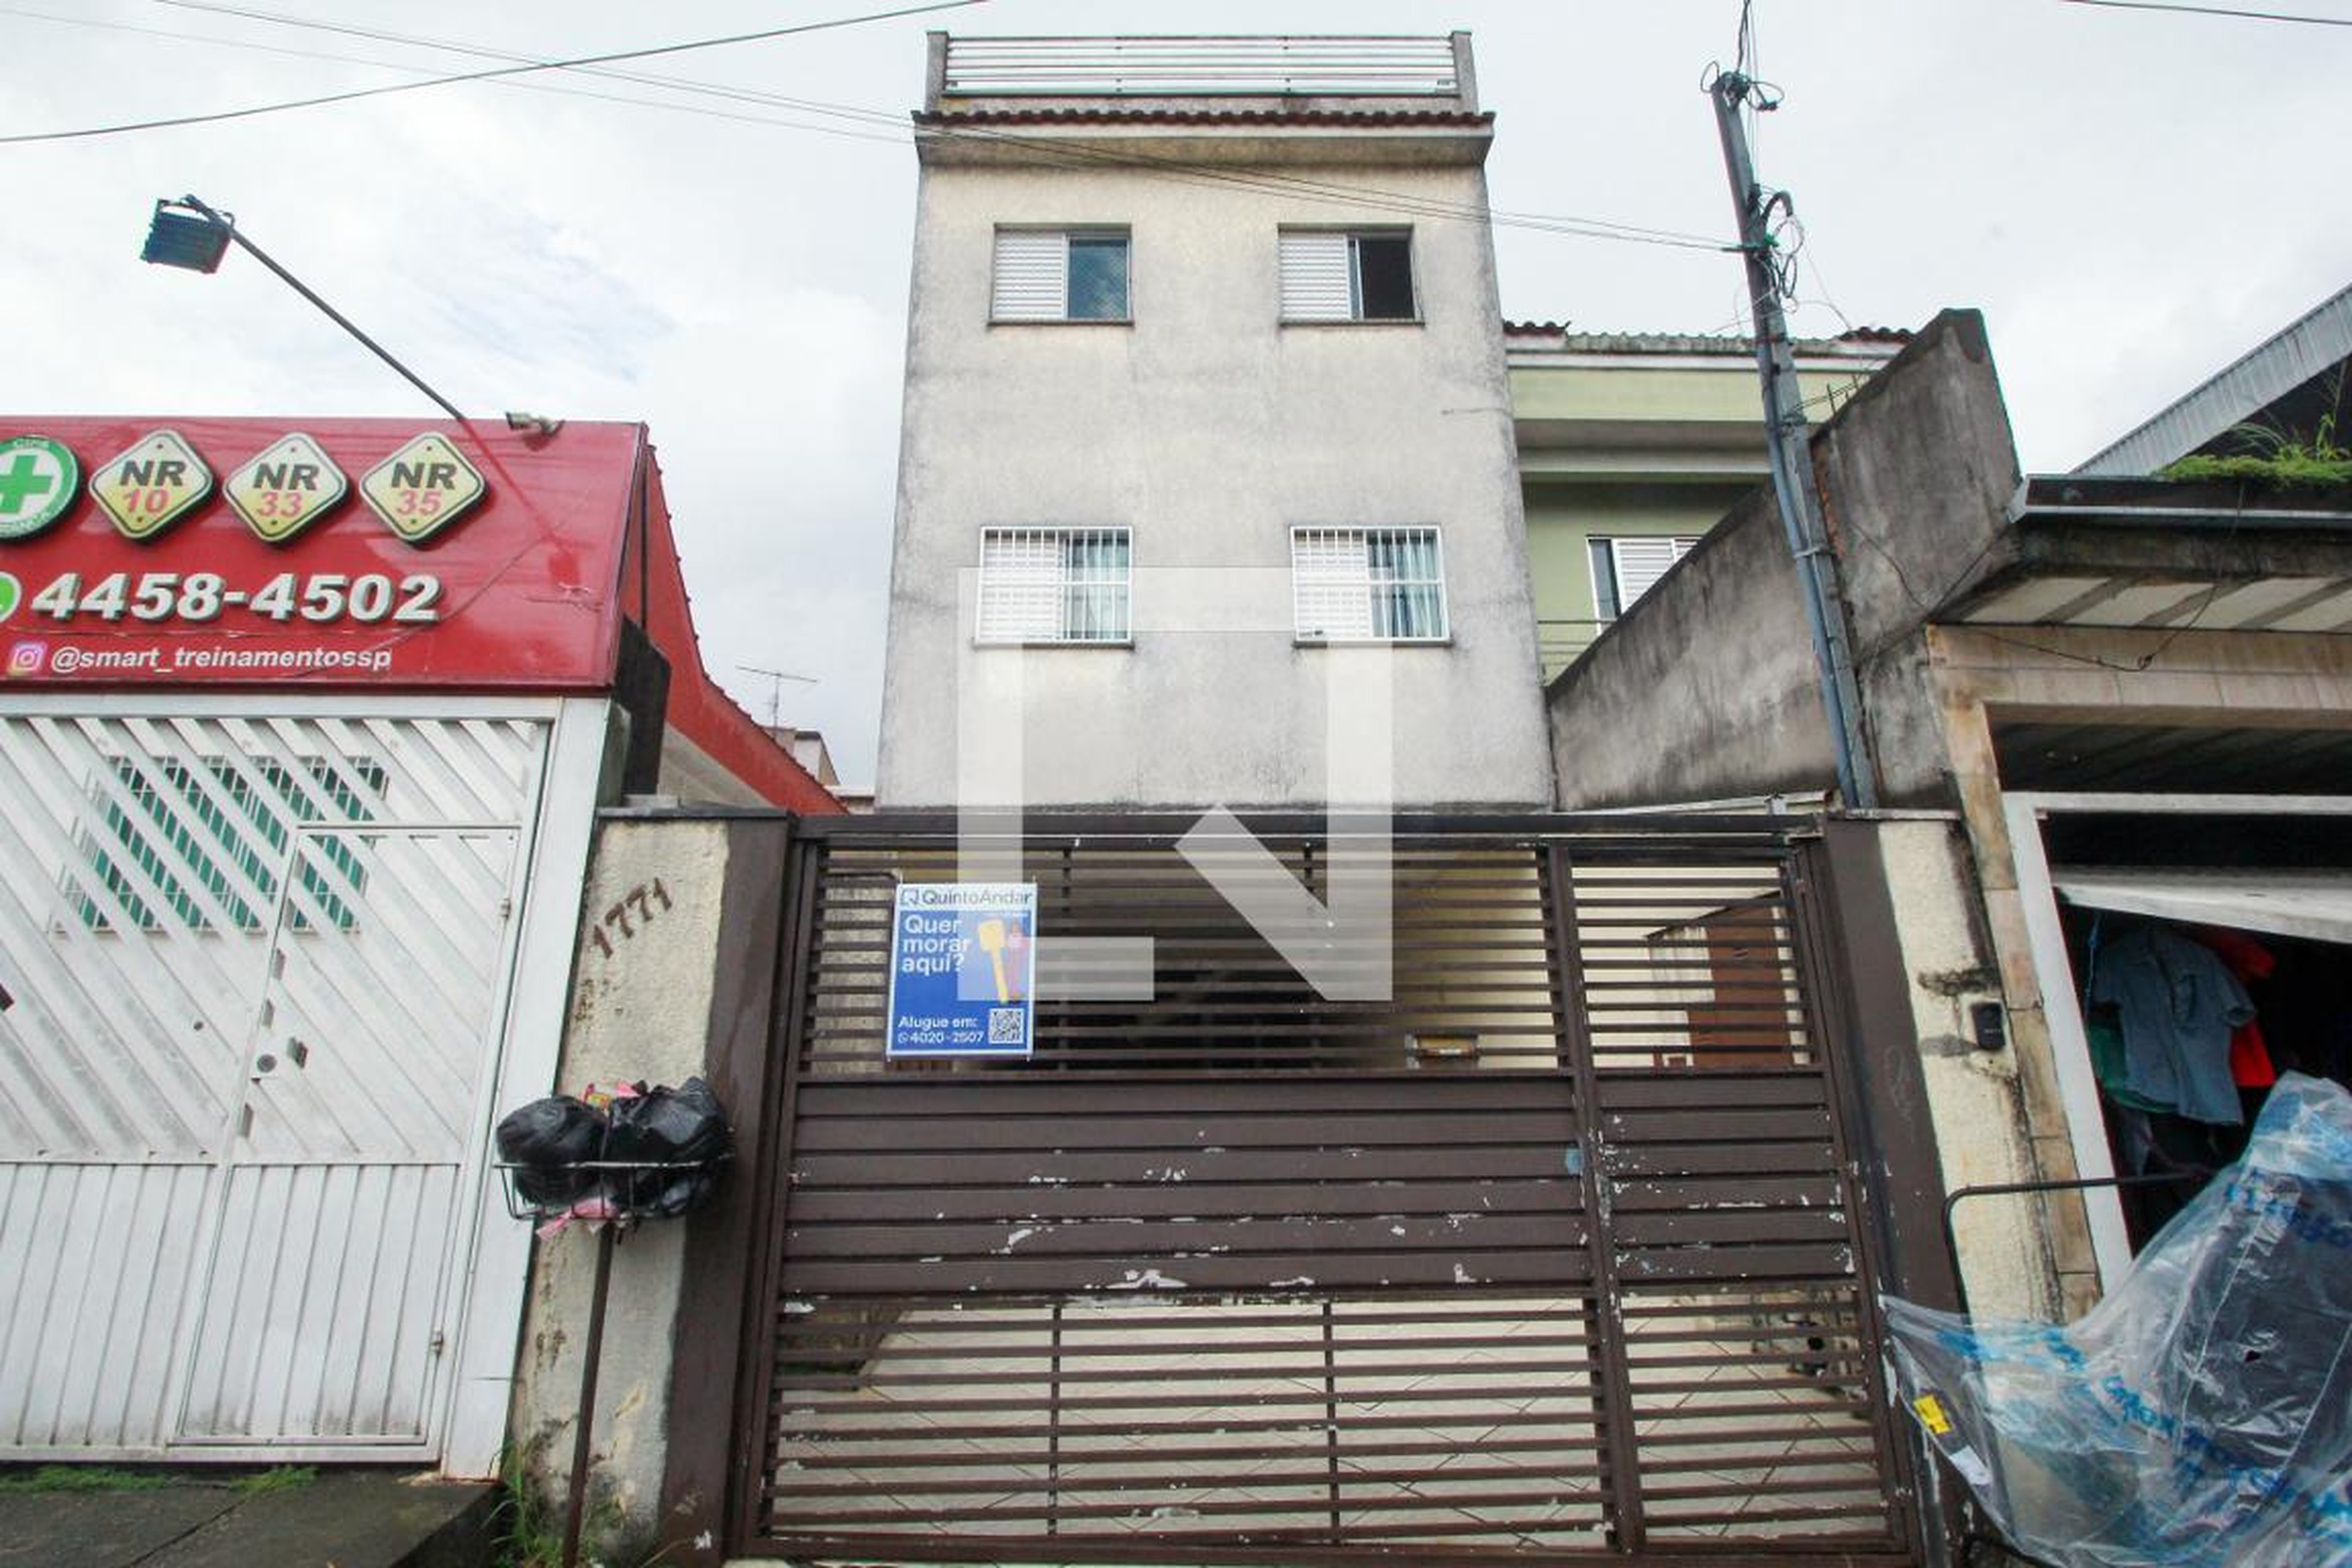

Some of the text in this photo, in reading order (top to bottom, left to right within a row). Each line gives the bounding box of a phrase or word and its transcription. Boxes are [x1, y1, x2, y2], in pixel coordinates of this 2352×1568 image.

[119, 460, 187, 486] NR
[252, 462, 320, 491] NR
[391, 461, 458, 490] NR
[123, 489, 169, 513] 10
[255, 491, 303, 518] 33
[395, 490, 442, 516] 35
[31, 573, 441, 621] 4458-4502
[51, 646, 392, 674] @smart_treinamentossp
[922, 889, 1033, 905] QuintoAndar
[594, 876, 672, 960] 1771
[905, 914, 962, 934] Quer
[903, 937, 972, 952] morar
[902, 953, 965, 976] aqui?
[898, 1017, 949, 1031] Alugue
